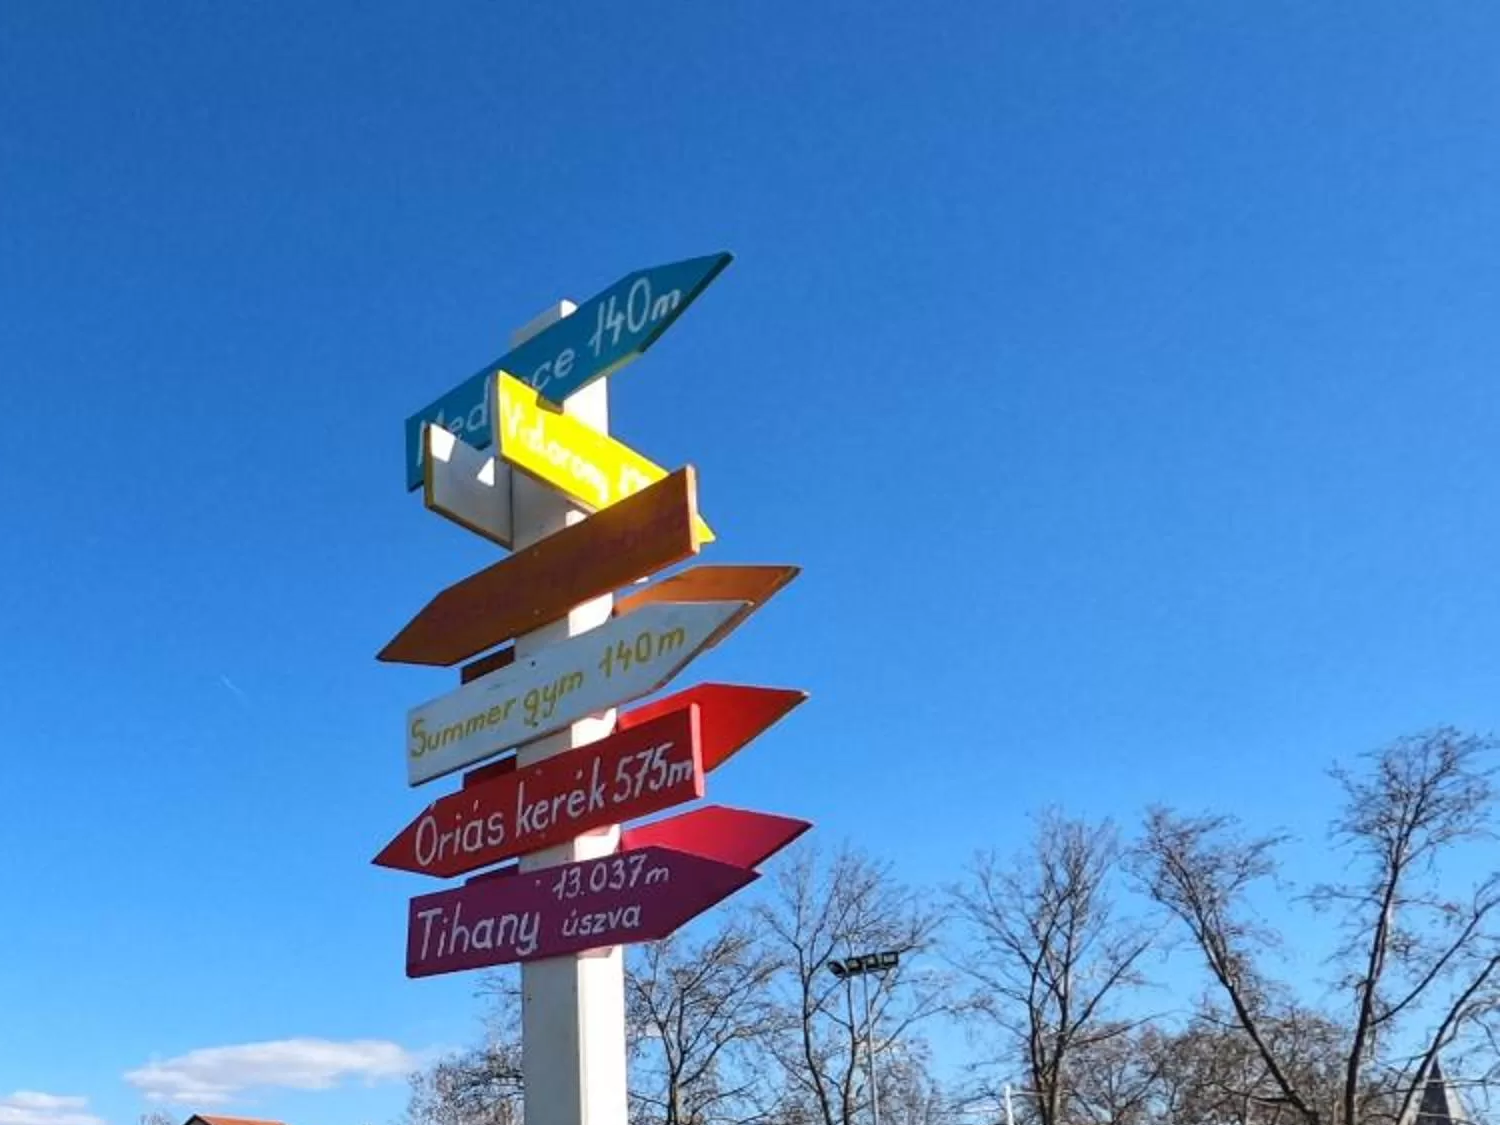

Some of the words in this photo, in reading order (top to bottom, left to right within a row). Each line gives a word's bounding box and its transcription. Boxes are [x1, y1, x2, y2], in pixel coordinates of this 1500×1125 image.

[588, 277, 681, 357] 140m
[411, 696, 517, 758] Summer
[523, 671, 583, 728] gym
[515, 757, 606, 838] kerék
[612, 742, 693, 802] 575m
[417, 901, 541, 960] Tihany
[562, 904, 642, 937] úszva
